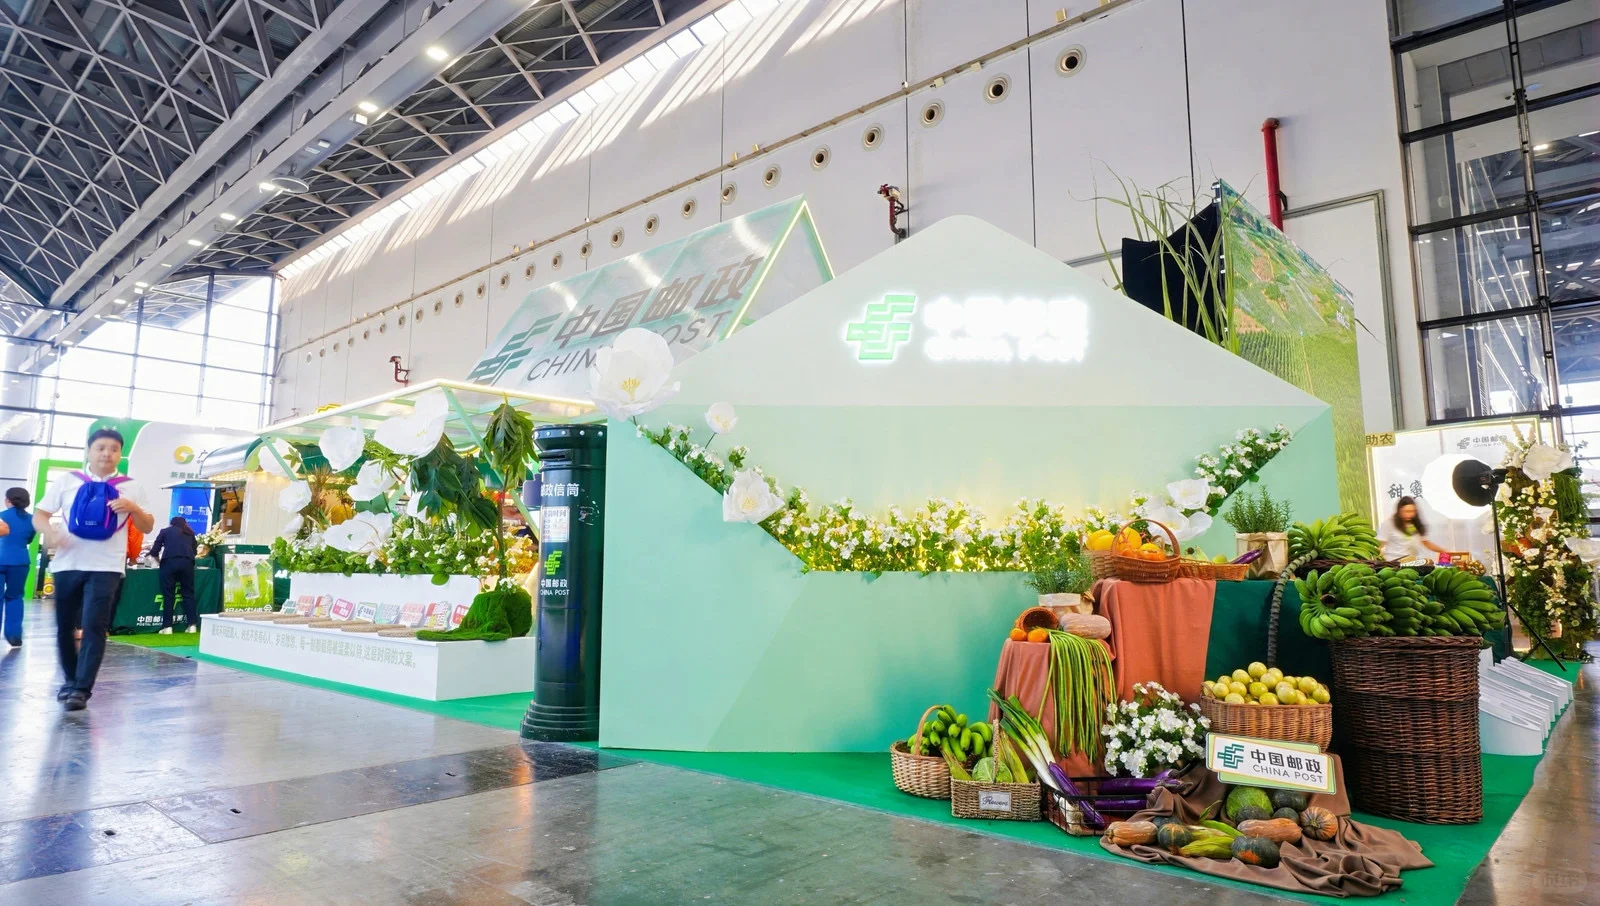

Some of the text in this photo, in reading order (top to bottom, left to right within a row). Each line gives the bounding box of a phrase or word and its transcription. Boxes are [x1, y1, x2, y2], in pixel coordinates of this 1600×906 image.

[554, 253, 763, 348] 中国邮政
[527, 310, 732, 381] CHIN OST
[1366, 433, 1392, 446] 助农
[1250, 748, 1322, 774] 中国邮政
[1252, 764, 1323, 784] CHINA POST
